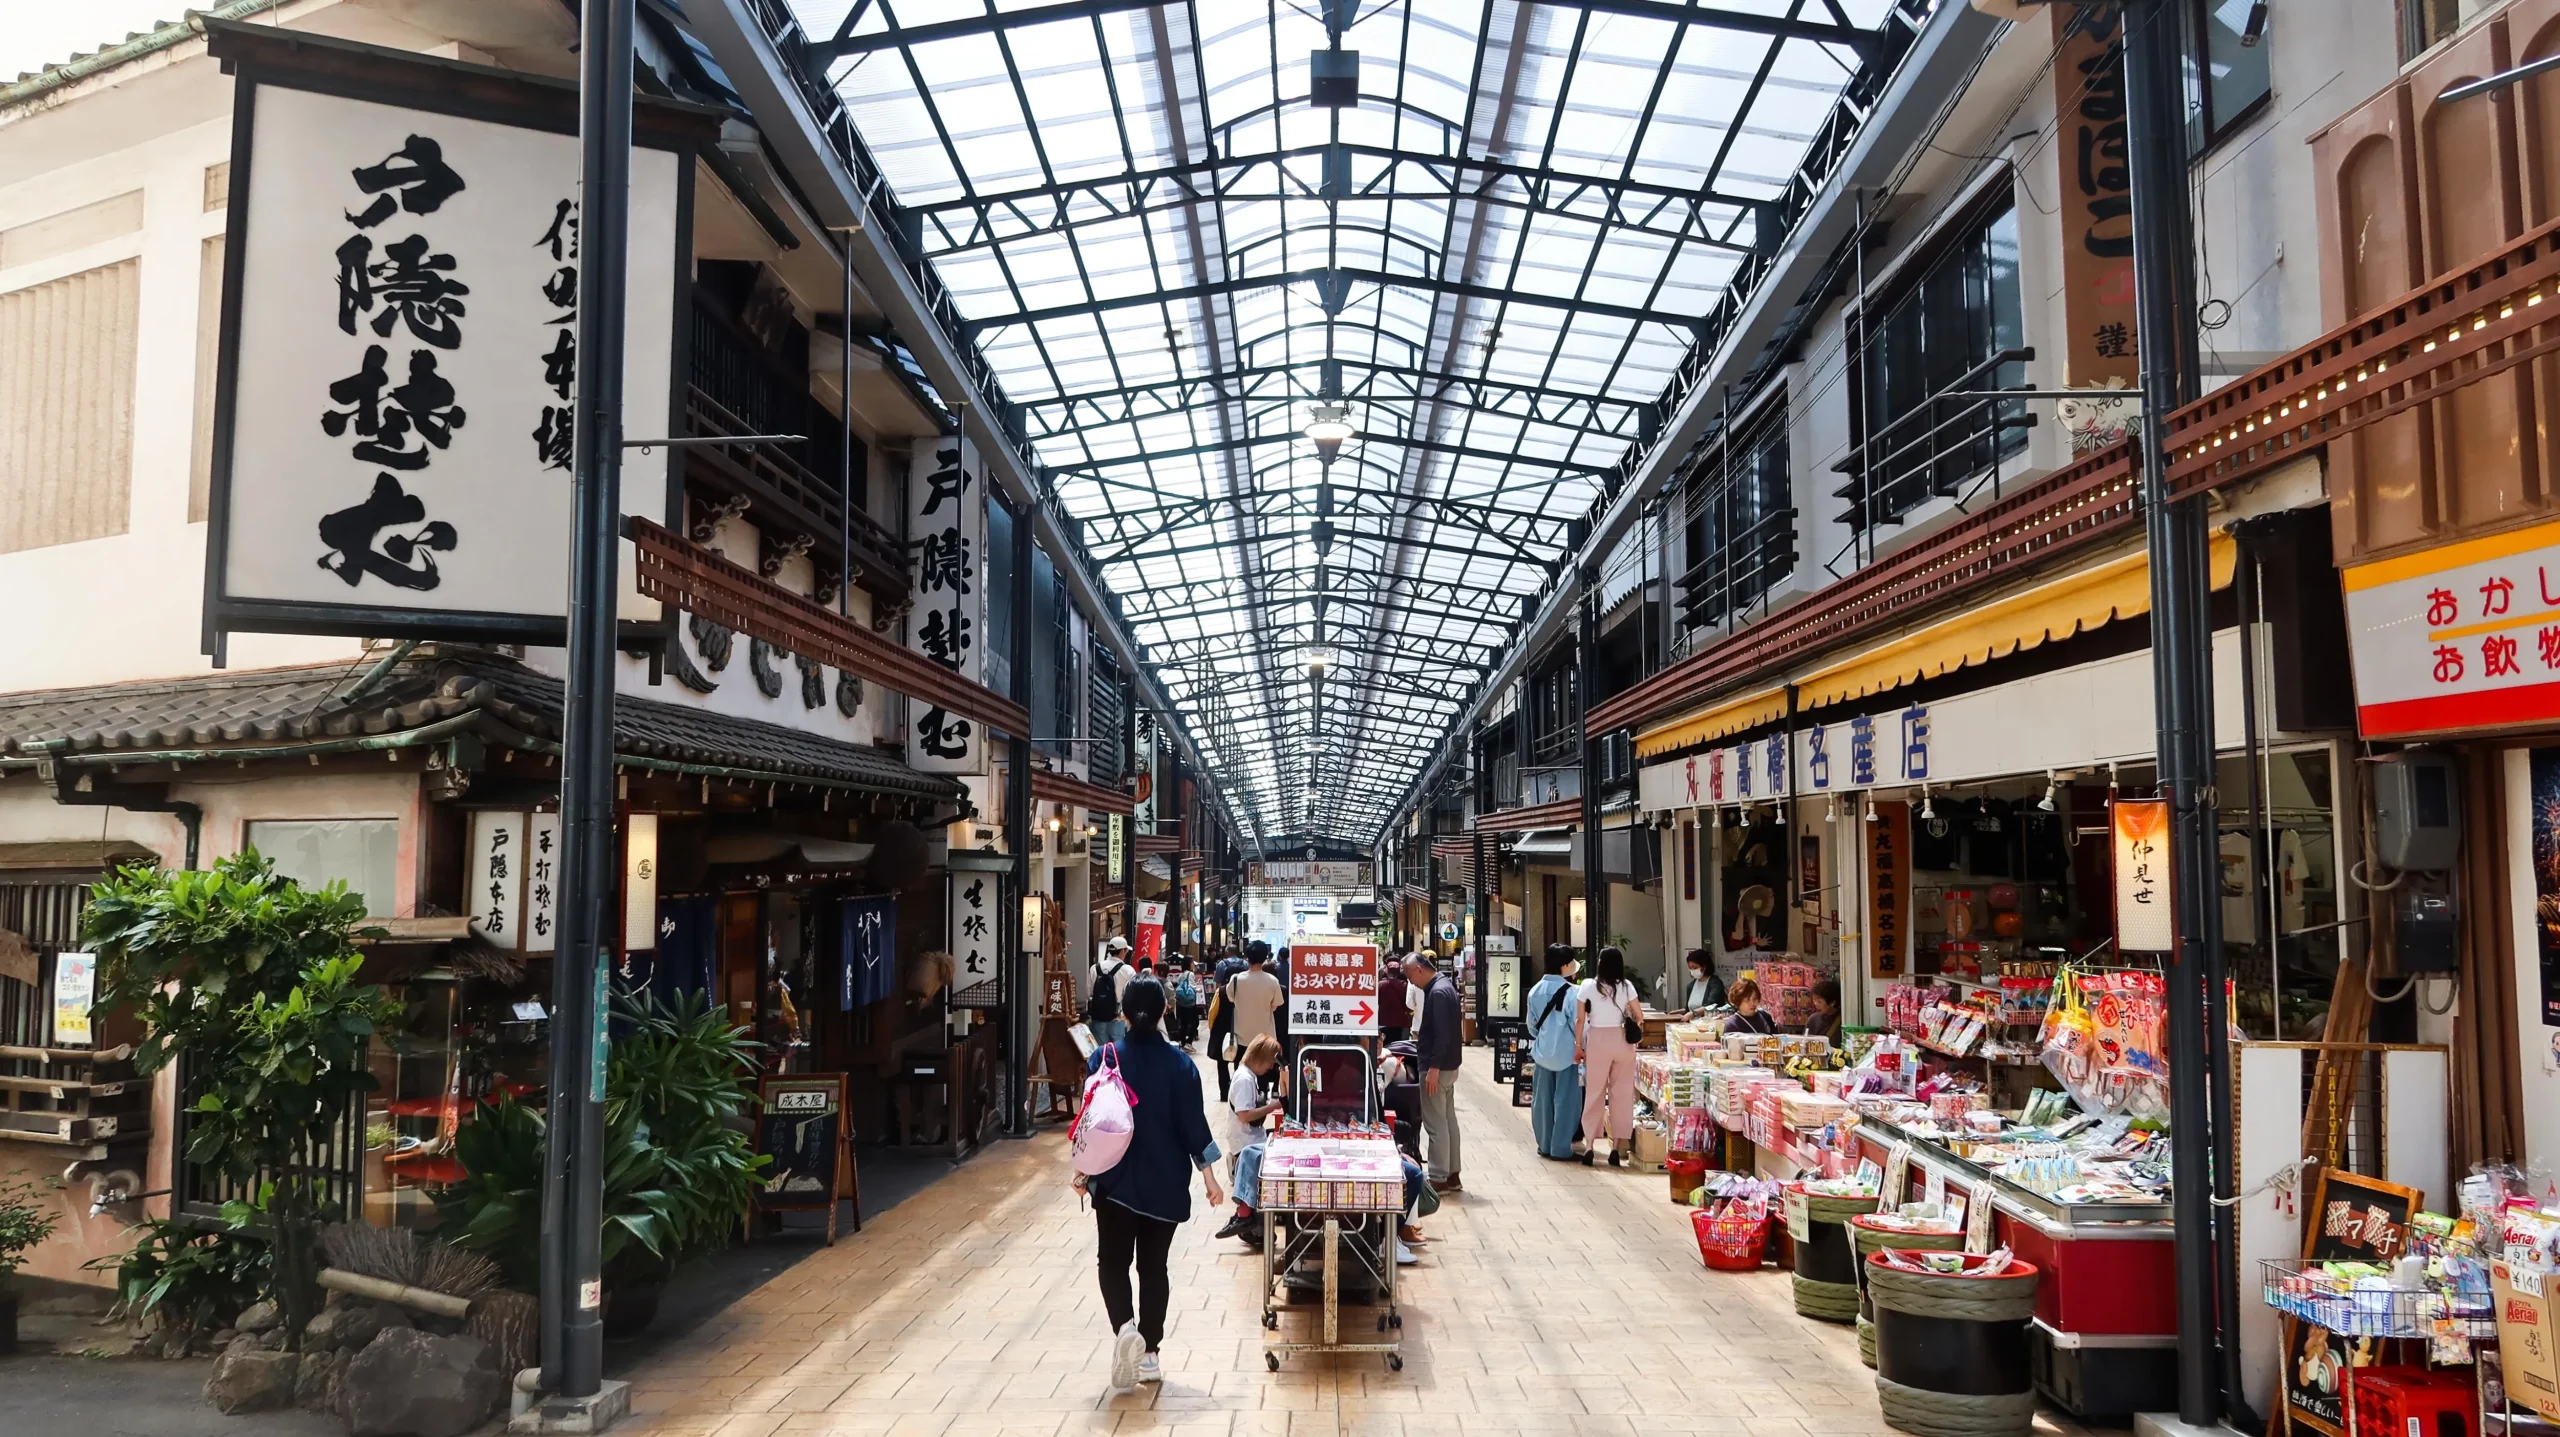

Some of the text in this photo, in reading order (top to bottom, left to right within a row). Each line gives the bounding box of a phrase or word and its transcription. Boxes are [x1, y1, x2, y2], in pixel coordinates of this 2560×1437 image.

[2131, 838, 2154, 904] 仲見世
[1304, 953, 1363, 967] 熱海温泉
[1293, 972, 1374, 990] おみやげ処
[1050, 979, 1062, 1013] 甘味処
[1306, 999, 1331, 1010] 丸福
[1292, 1012, 1344, 1024] 高橋商店
